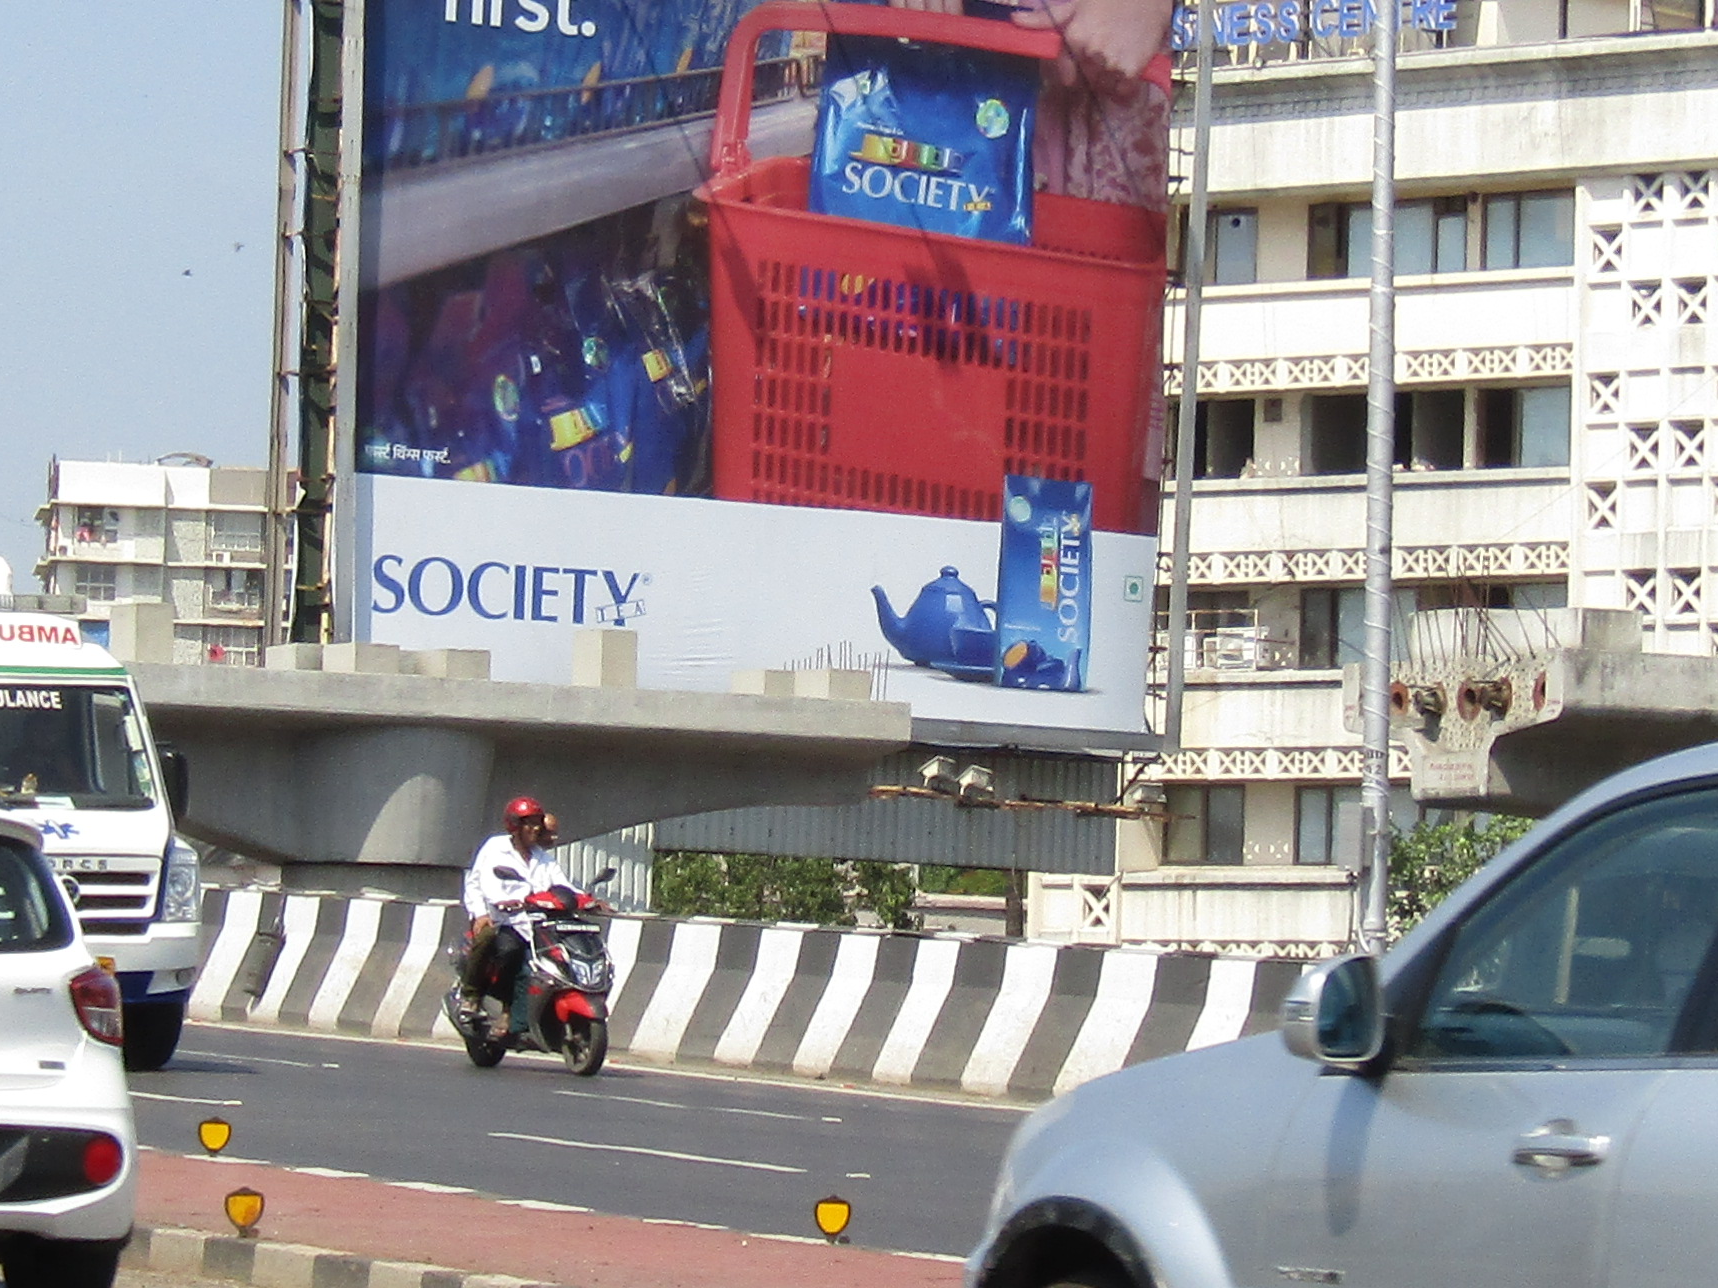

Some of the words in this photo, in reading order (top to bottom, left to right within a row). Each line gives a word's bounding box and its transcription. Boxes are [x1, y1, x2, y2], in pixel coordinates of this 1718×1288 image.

[842, 161, 990, 214] SOCIETY
[371, 554, 641, 627] SOCIETY
[1057, 510, 1081, 644] SOCIETY
